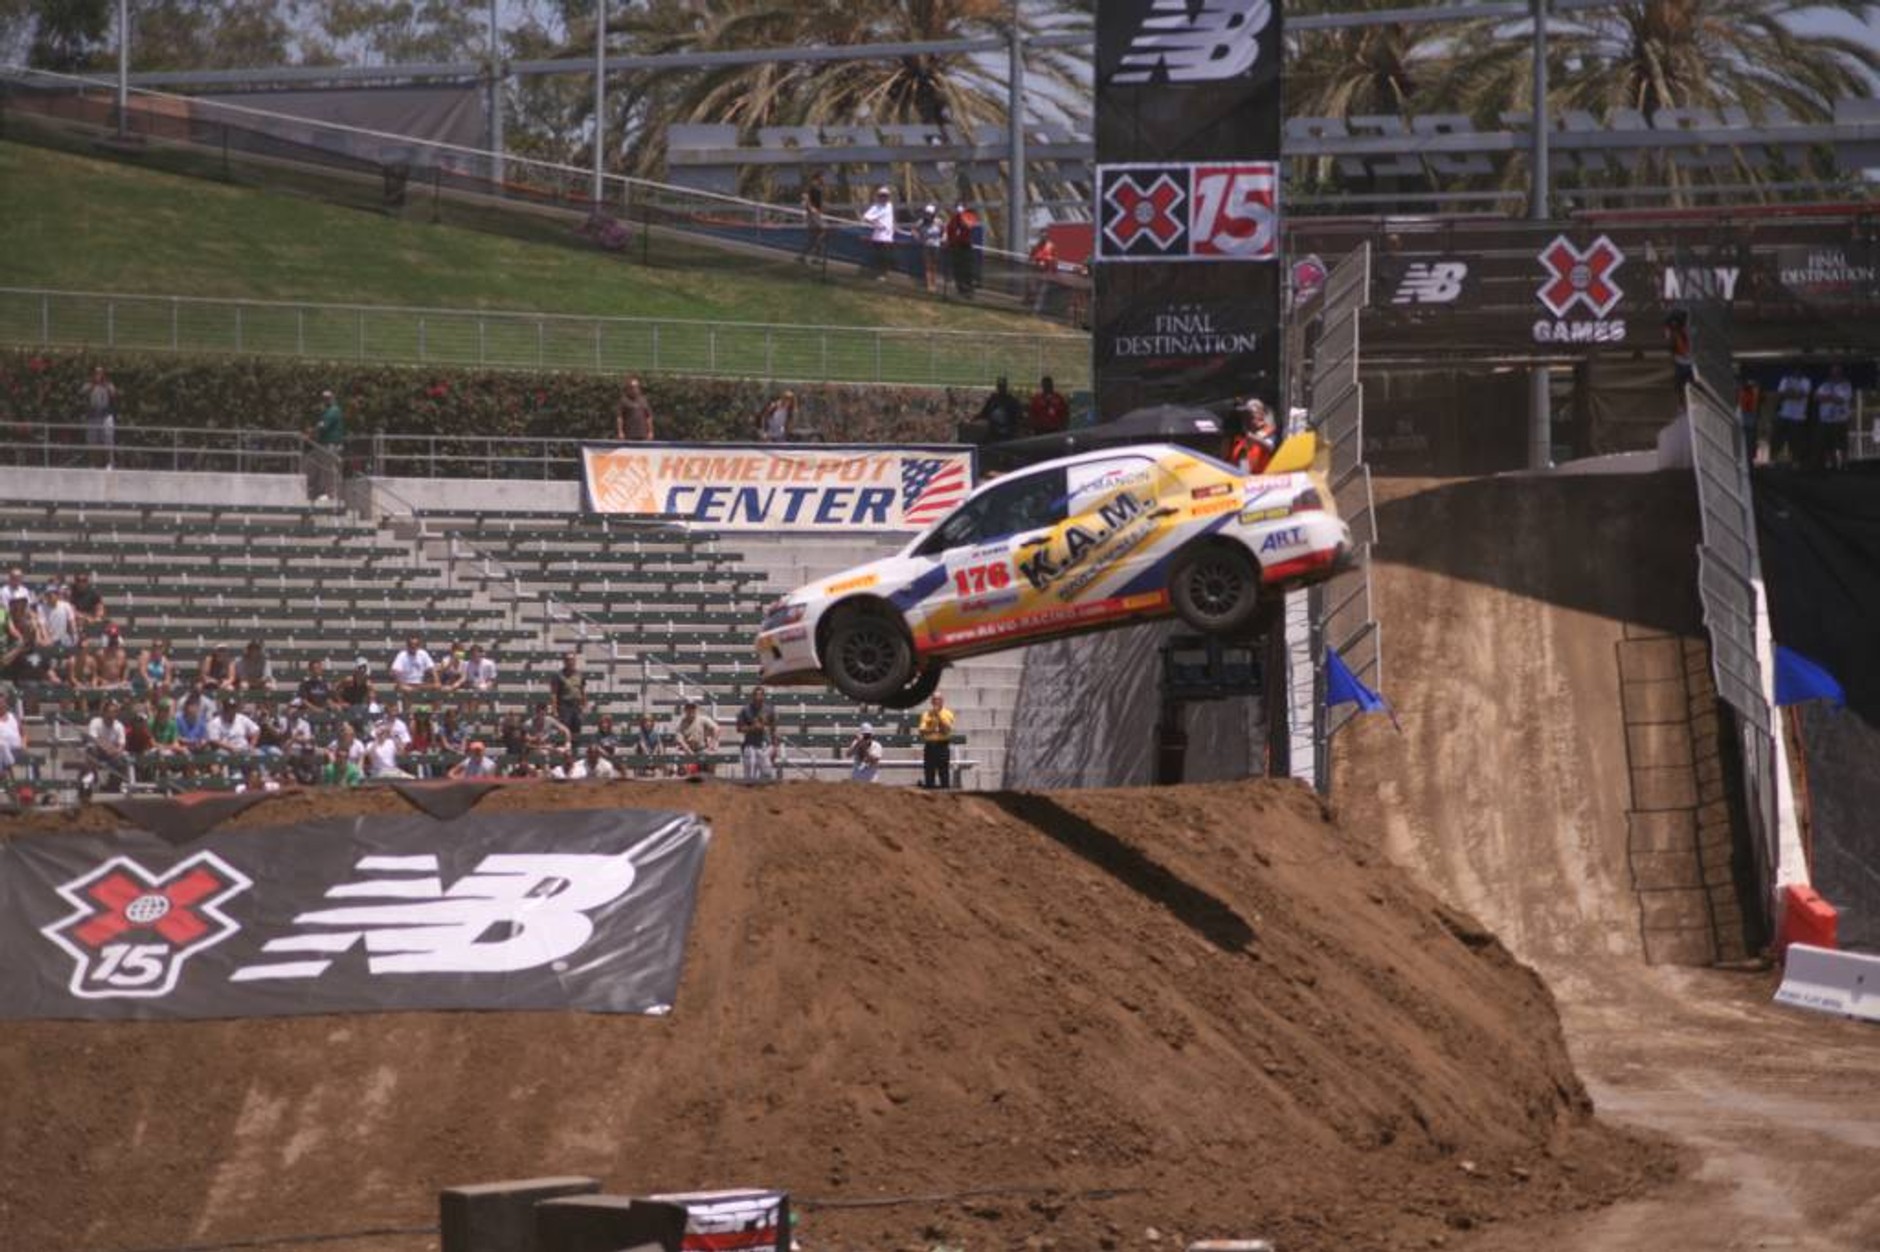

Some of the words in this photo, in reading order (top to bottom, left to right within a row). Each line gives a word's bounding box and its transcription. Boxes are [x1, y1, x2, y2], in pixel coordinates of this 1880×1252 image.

[1193, 173, 1275, 256] 15
[1780, 266, 1876, 283] DESTINATION
[1155, 314, 1216, 334] FINAL
[1532, 320, 1626, 343] GAMES
[1115, 334, 1257, 356] DESTINATION
[658, 456, 766, 481] HOME
[768, 455, 894, 481] DEPOT
[664, 487, 896, 524] CENTER
[954, 561, 1011, 597] 176
[90, 943, 170, 986] 15
